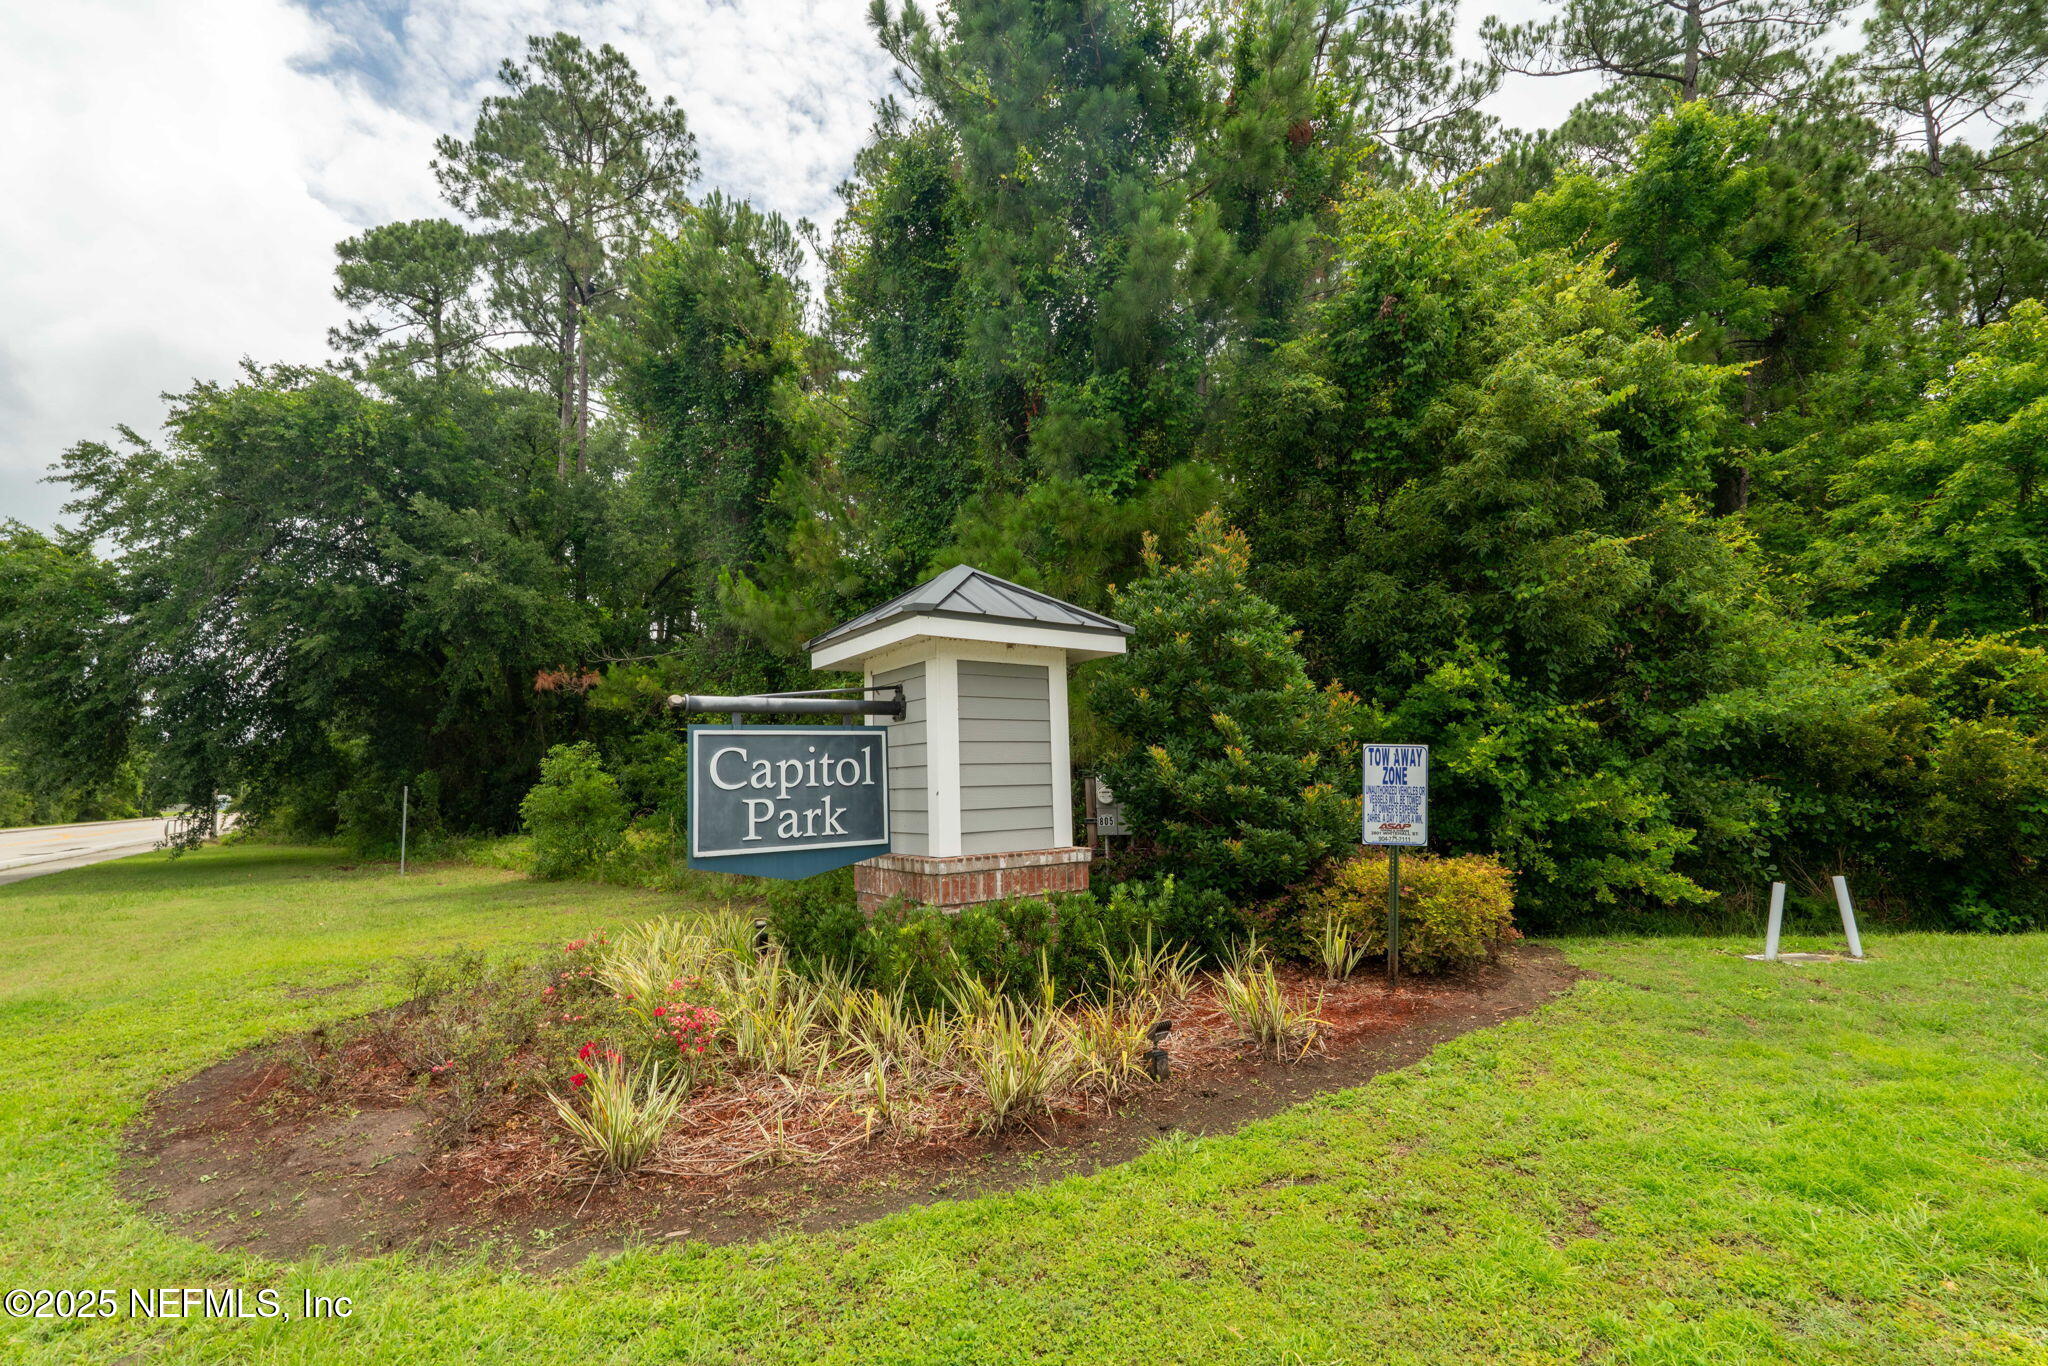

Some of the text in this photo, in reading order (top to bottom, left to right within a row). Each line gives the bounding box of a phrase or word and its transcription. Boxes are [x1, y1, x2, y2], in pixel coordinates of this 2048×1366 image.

[1368, 748, 1422, 767] TOW AWAY
[709, 746, 875, 800] Capitol
[1382, 766, 1408, 785] ZONE
[1366, 785, 1397, 795] UNAUTHORIZED
[1398, 786, 1418, 796] VEHICLES
[1369, 795, 1388, 804] VESSELS
[1400, 795, 1406, 805] BE
[1406, 795, 1421, 806] TOWED
[742, 795, 848, 841] Park
[1100, 816, 1114, 826] 805
